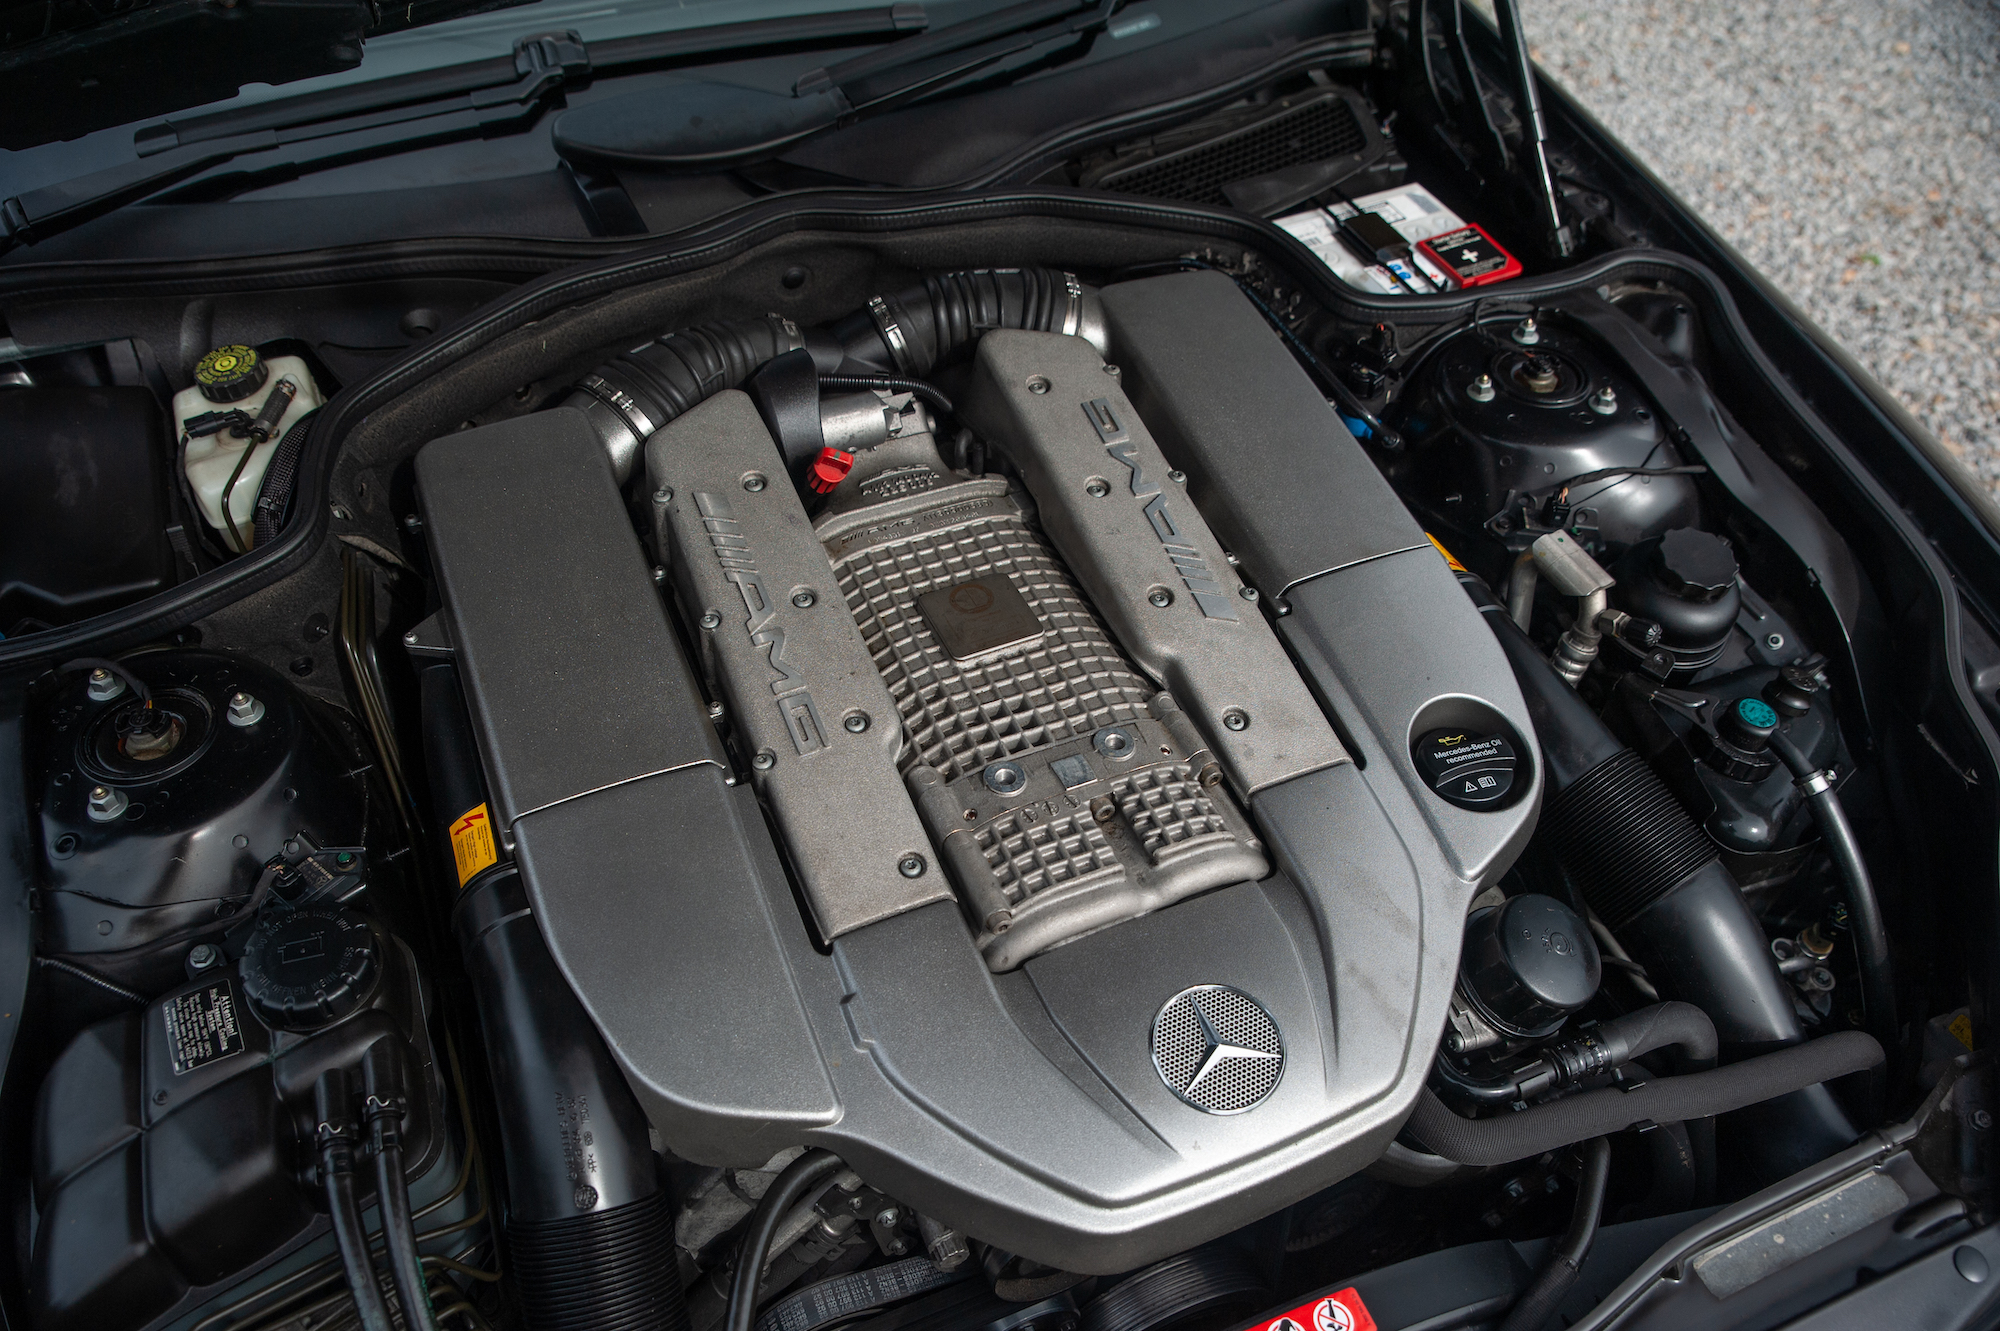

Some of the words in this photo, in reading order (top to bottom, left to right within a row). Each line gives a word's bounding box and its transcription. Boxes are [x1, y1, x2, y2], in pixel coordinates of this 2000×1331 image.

[1080, 397, 1198, 553] AMG
[724, 570, 832, 757] AMG
[1434, 741, 1491, 760] Mercedes-Benz
[1490, 738, 1502, 747] Oil
[1446, 748, 1498, 764] recommended
[266, 920, 283, 936] NOT
[285, 910, 309, 923] OPEN
[209, 987, 220, 1001] High
[206, 1009, 216, 1032] System
[213, 1001, 223, 1026] Pressure
[219, 995, 238, 1038] Attention!
[219, 1027, 229, 1052] Cooling
[825, 1294, 835, 1302] 00
[836, 1290, 850, 1299] 997
[850, 1286, 864, 1295] 113
[852, 1292, 865, 1301] 113
[813, 1298, 824, 1306] 92
[815, 1304, 826, 1312] 92
[827, 1300, 837, 1308] 00
[838, 1296, 852, 1305] 997
